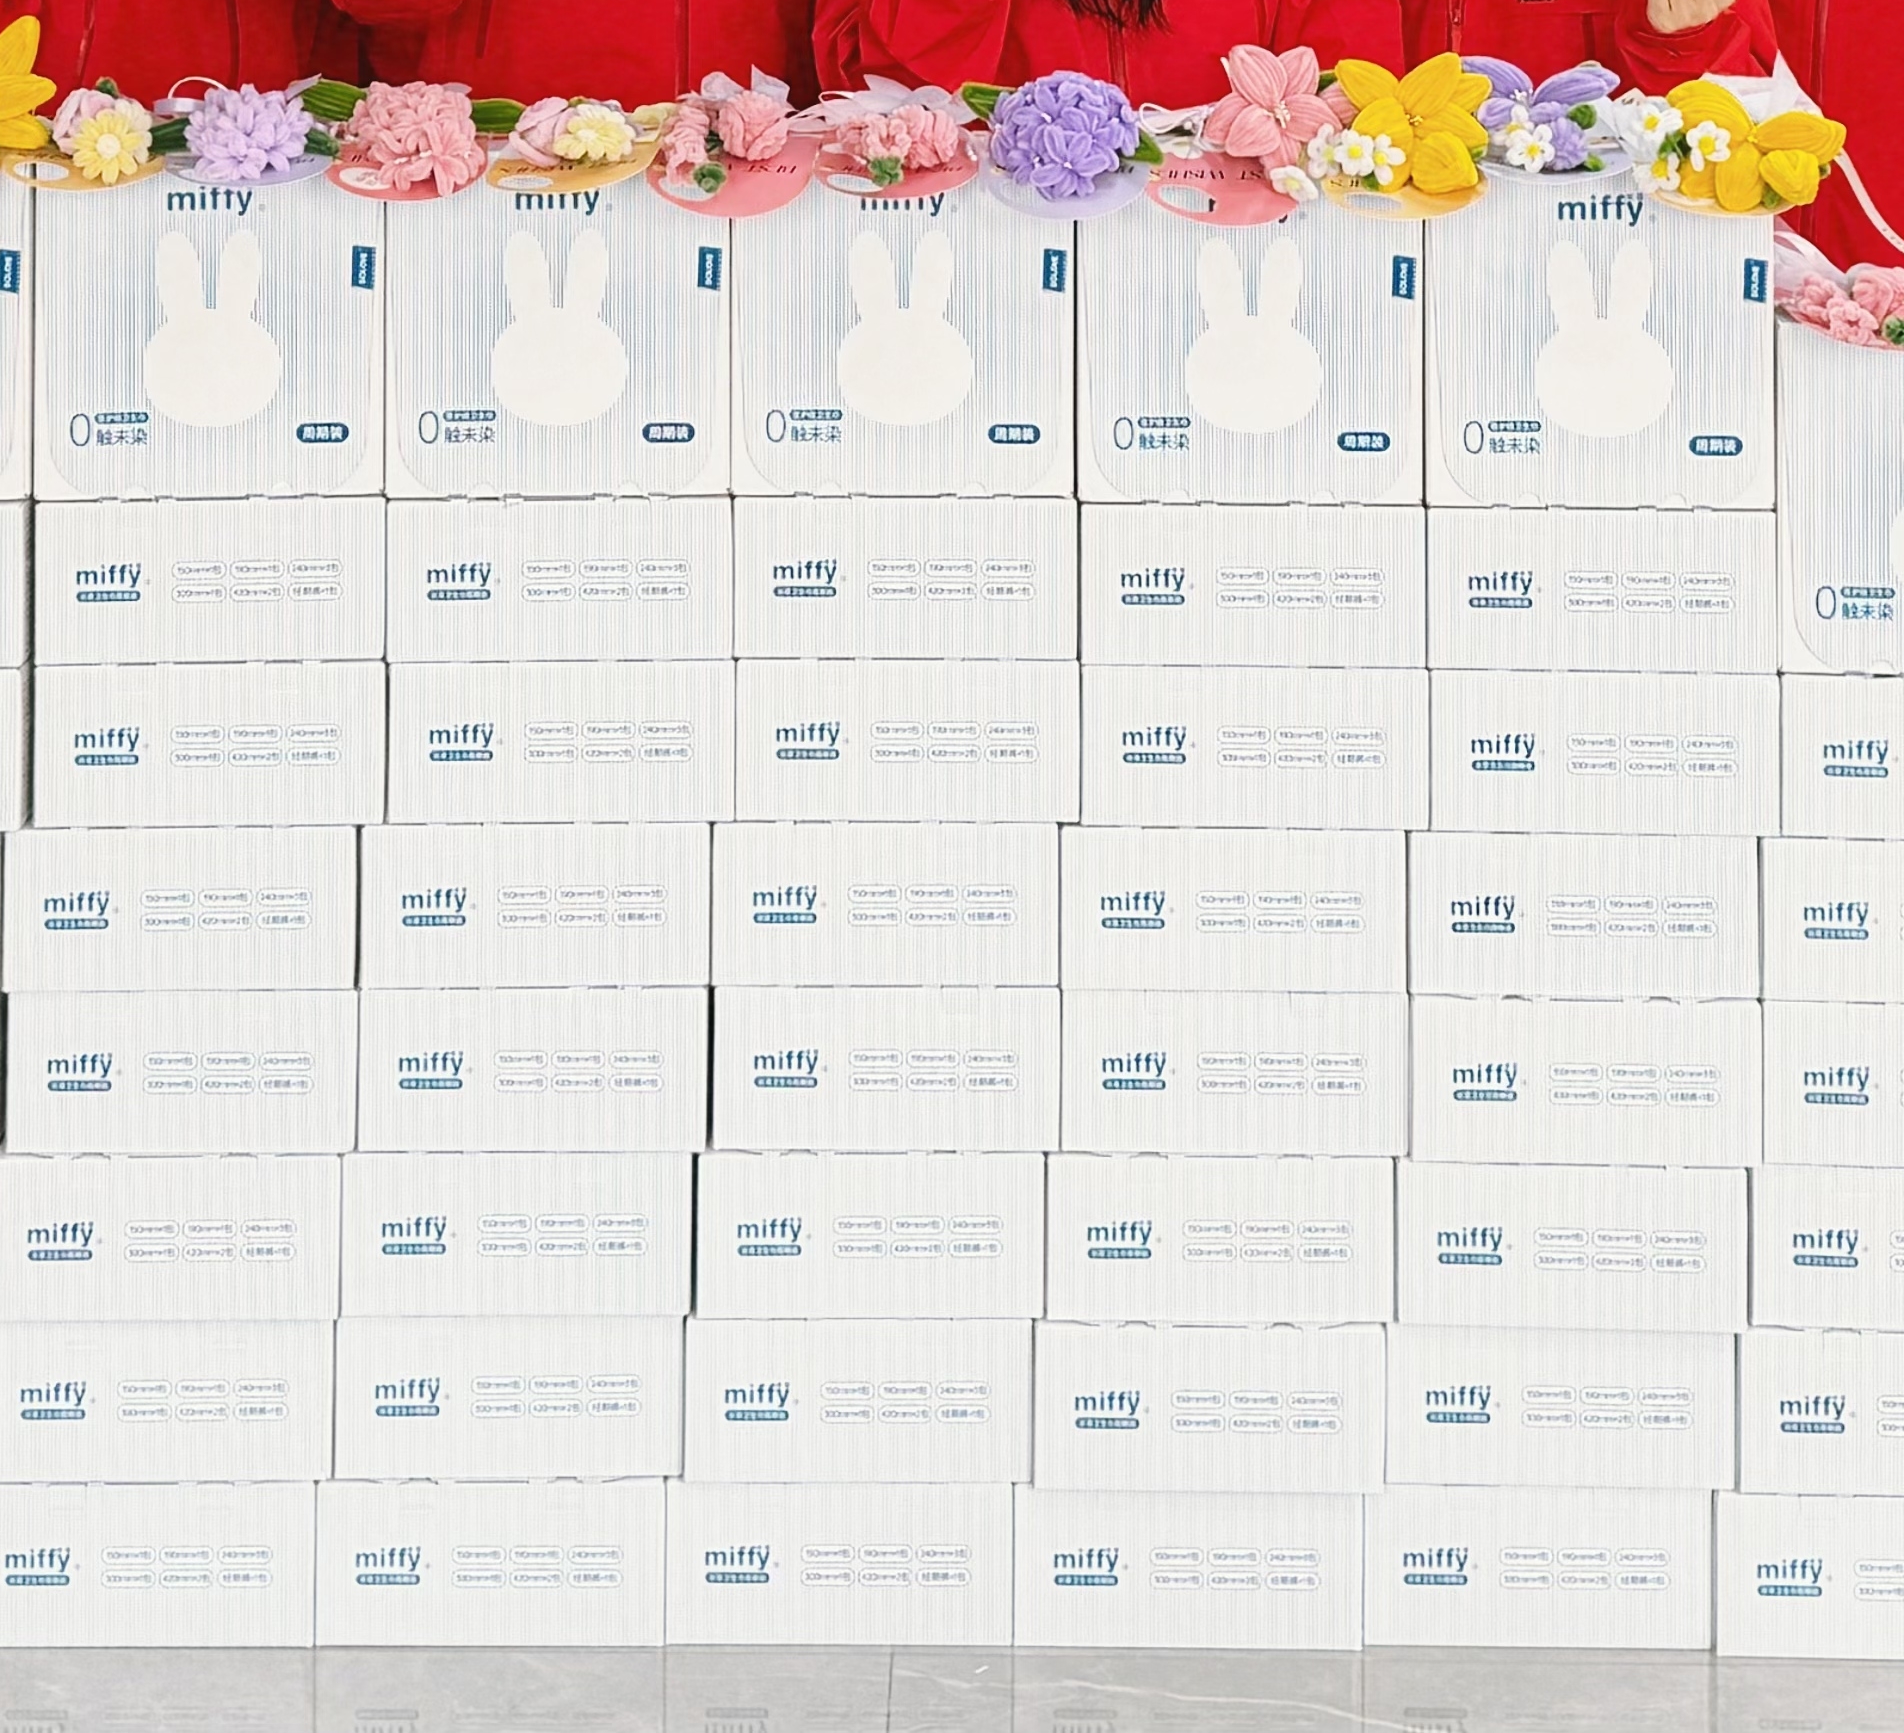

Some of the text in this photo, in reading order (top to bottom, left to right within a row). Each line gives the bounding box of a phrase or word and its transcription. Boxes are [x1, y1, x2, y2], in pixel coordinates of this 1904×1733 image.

[1558, 194, 1643, 226] miffy
[76, 563, 141, 589] miffy
[427, 562, 491, 588] miffy
[773, 559, 837, 585] miffy
[1120, 567, 1185, 592] miffy
[1468, 571, 1533, 596] miffy
[74, 727, 140, 753] miffy
[429, 723, 494, 749] miffy
[776, 721, 840, 747] miffy
[1122, 726, 1187, 752] miffy
[1471, 733, 1535, 759] miffy
[1823, 740, 1889, 765] miffy
[44, 890, 110, 917] miffy
[402, 887, 467, 913] miffy
[753, 885, 817, 911] miffy
[1100, 890, 1165, 916] miffy
[1451, 895, 1515, 921] miffy
[1803, 902, 1869, 927] miffy
[47, 1053, 113, 1079] miffy
[399, 1051, 464, 1077] miffy
[754, 1049, 819, 1075] miffy
[1102, 1052, 1166, 1078] miffy
[1453, 1063, 1517, 1089] miffy
[1804, 1066, 1869, 1092] miffy
[27, 1221, 94, 1248] miffy
[382, 1216, 447, 1242] miffy
[737, 1217, 802, 1243] miffy
[1087, 1220, 1152, 1246] miffy
[1437, 1227, 1503, 1252] miffy
[1793, 1229, 1858, 1255] miffy
[20, 1382, 86, 1407] miffy
[375, 1377, 440, 1404] miffy
[725, 1383, 790, 1408] miffy
[1075, 1390, 1140, 1416] miffy
[1426, 1385, 1491, 1411] miffy
[1780, 1395, 1845, 1421] miffy
[5, 1547, 70, 1573] miffy
[356, 1546, 421, 1572] miffy
[705, 1545, 770, 1571] miffy
[1054, 1548, 1119, 1573] miffy
[1403, 1547, 1468, 1573] miffy
[1757, 1559, 1823, 1584] miffy
